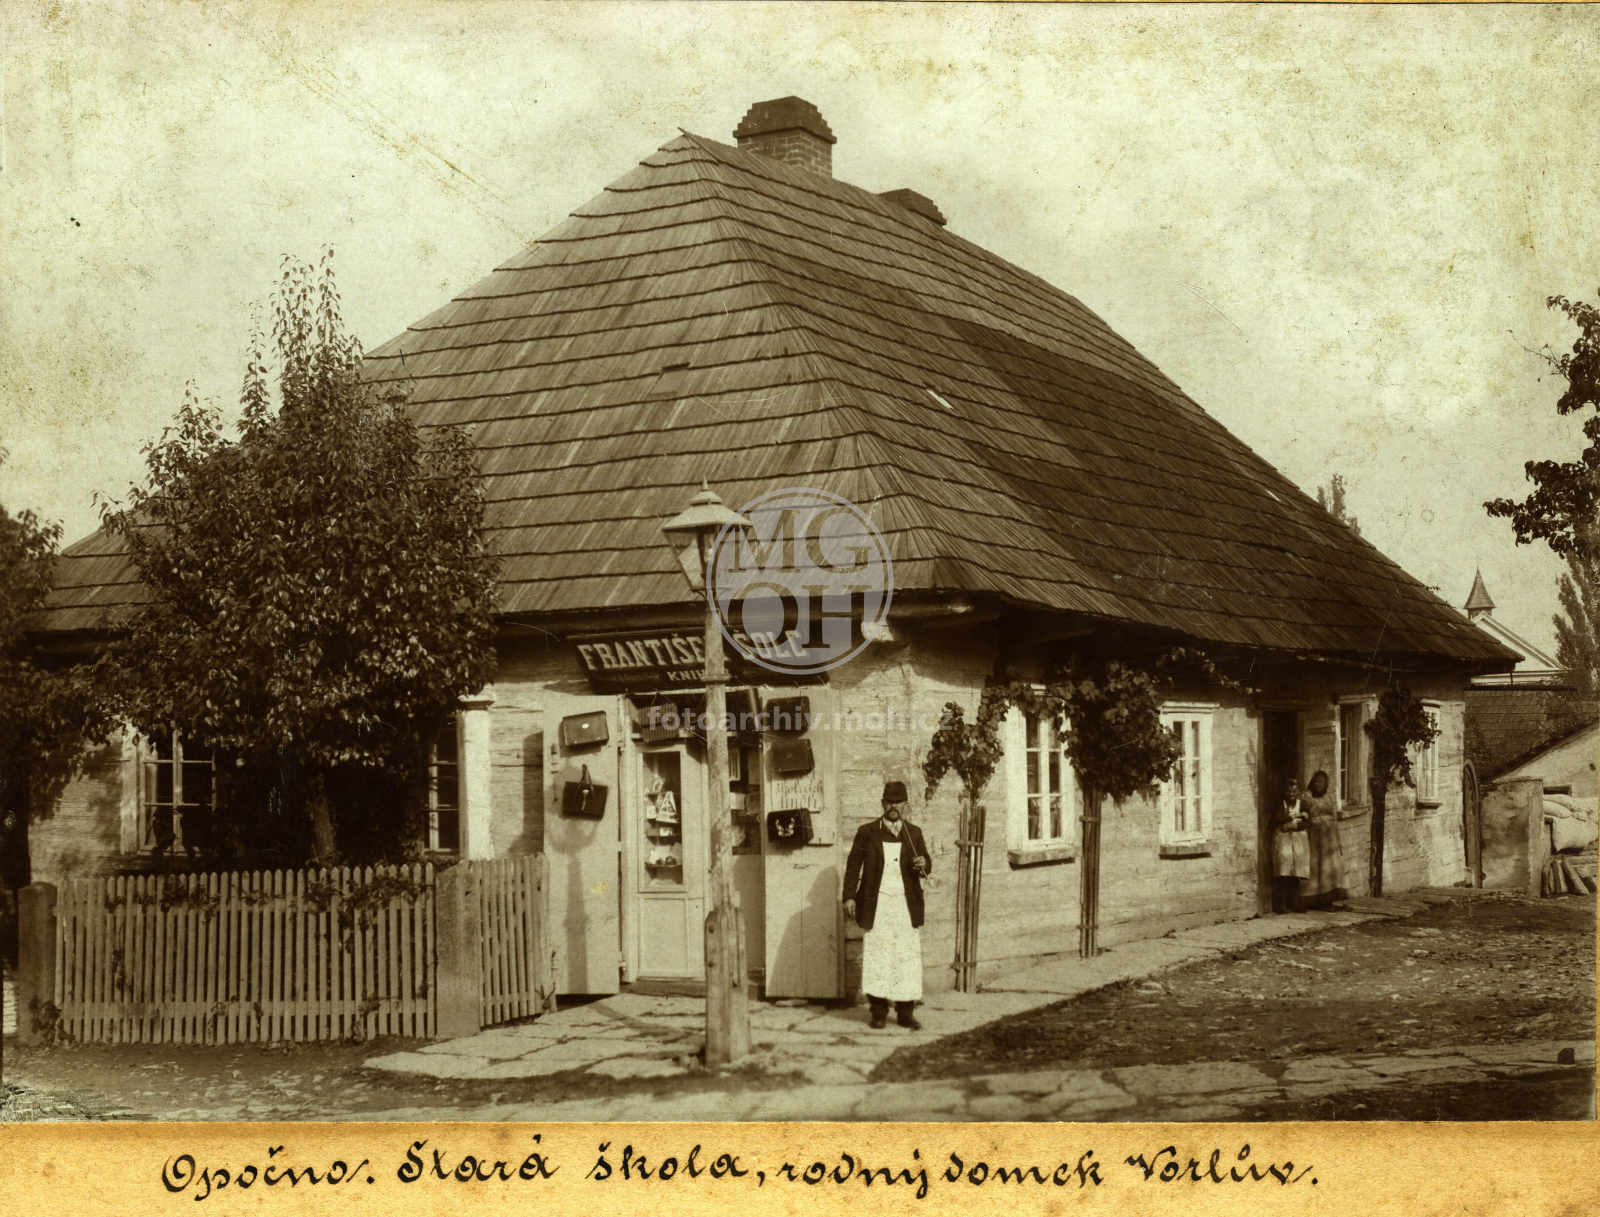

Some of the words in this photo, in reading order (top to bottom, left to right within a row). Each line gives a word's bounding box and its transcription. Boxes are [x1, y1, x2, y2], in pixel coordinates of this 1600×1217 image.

[577, 632, 731, 670] FRANTIŠE
[161, 1145, 375, 1202] Opočno.
[940, 1149, 1104, 1188] domek
